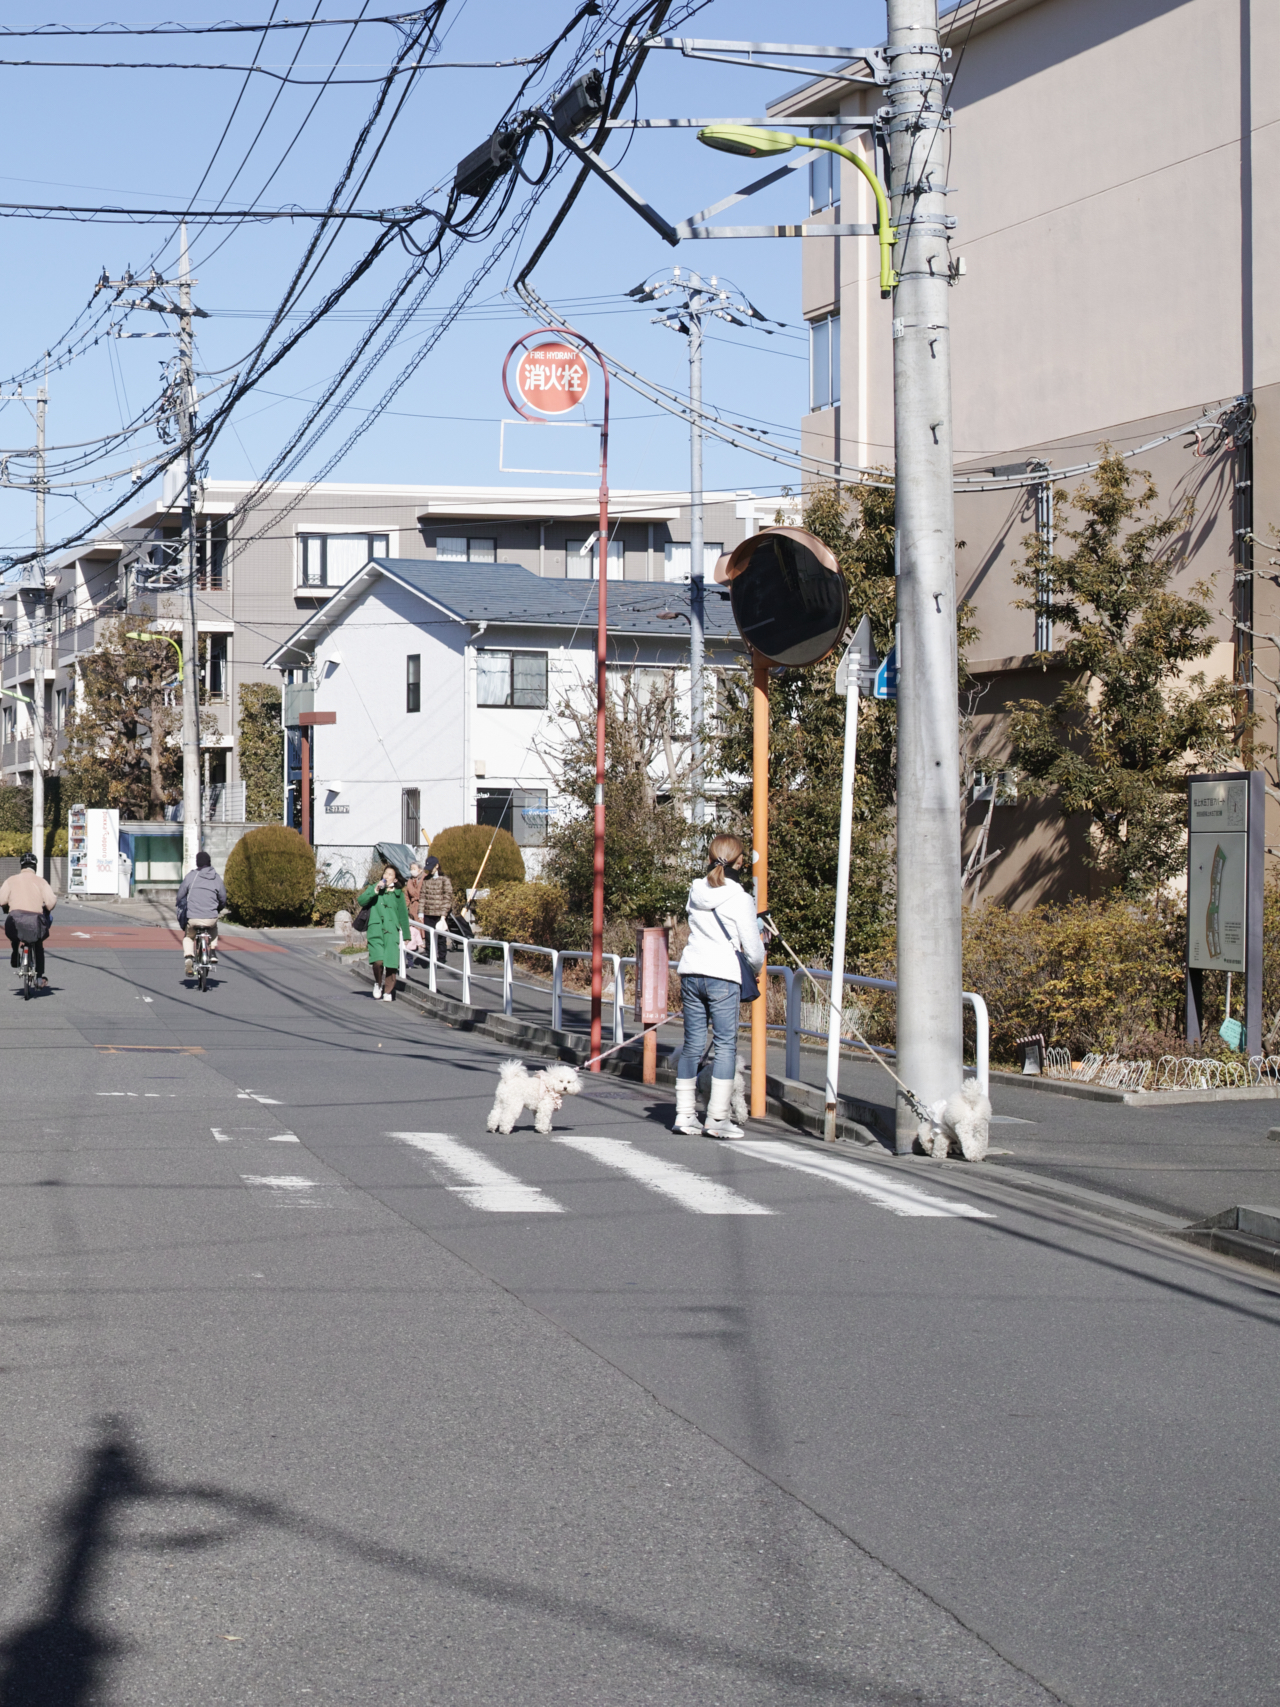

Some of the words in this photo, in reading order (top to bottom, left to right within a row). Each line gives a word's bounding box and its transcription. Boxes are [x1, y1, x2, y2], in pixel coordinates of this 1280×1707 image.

[529, 351, 545, 360] FIRE
[546, 351, 577, 360] HYDRANT
[524, 363, 584, 392] 消火栓
